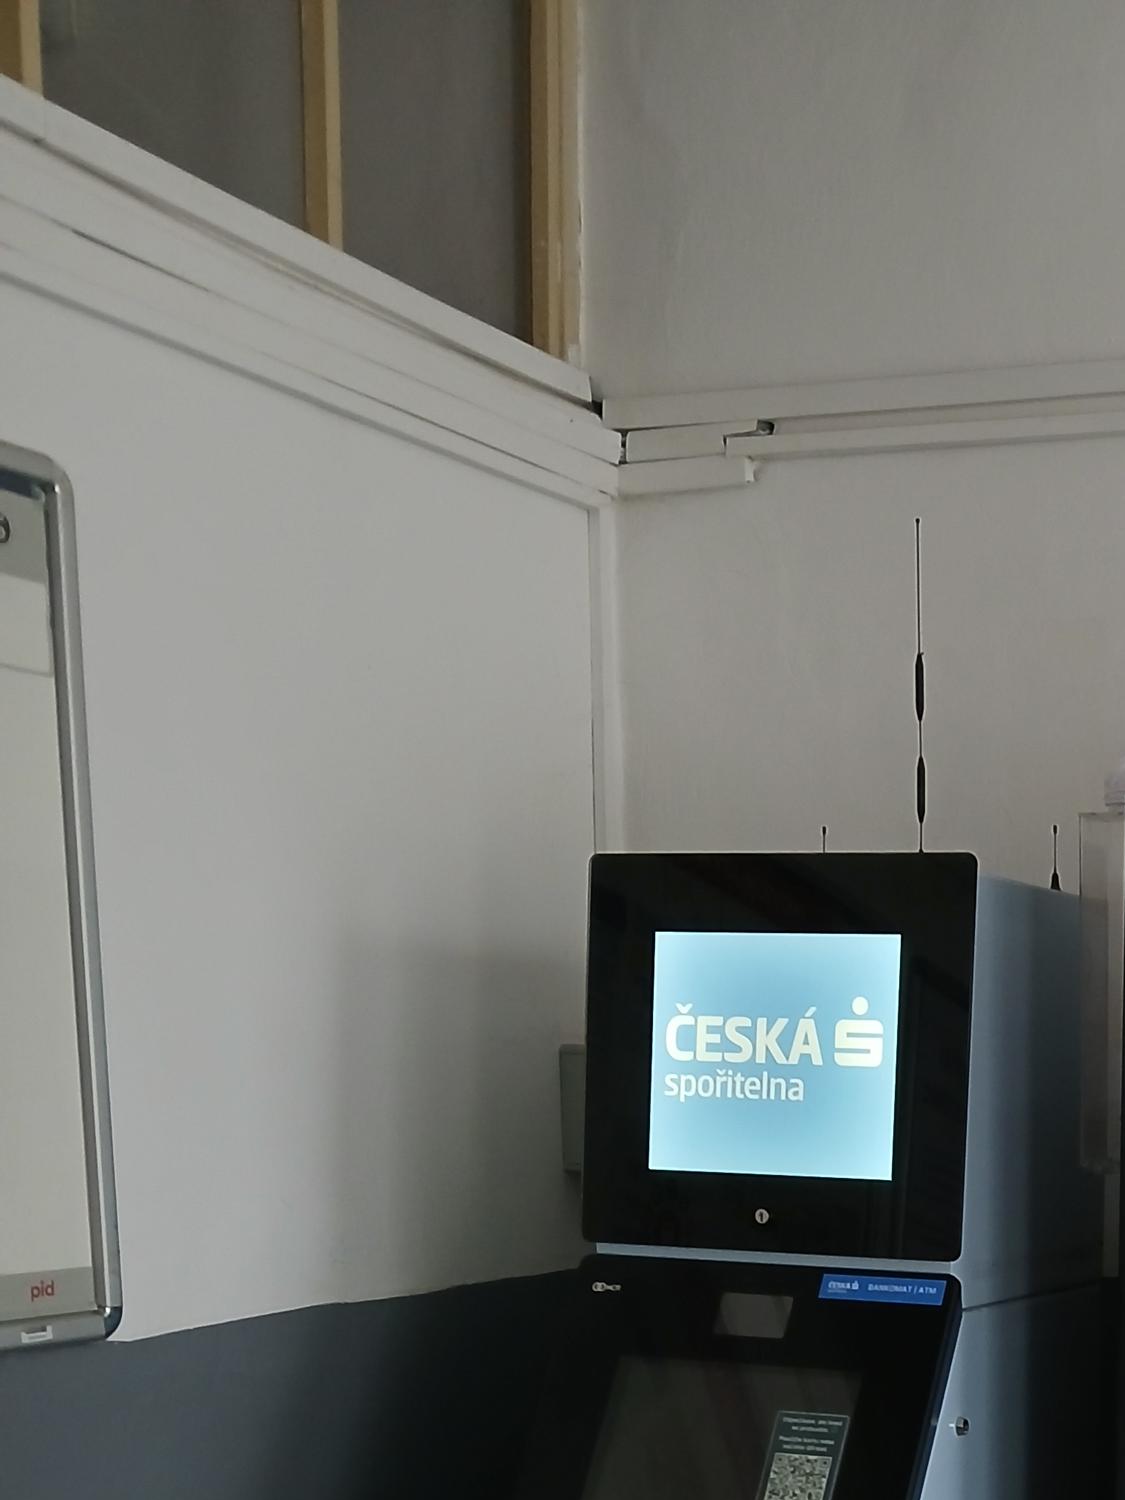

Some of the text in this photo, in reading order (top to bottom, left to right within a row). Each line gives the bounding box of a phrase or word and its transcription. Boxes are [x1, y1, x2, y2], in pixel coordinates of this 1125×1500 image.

[666, 1003, 823, 1066] ČESKÁ
[664, 1068, 805, 1103] spořitelna
[31, 1280, 55, 1302] pid
